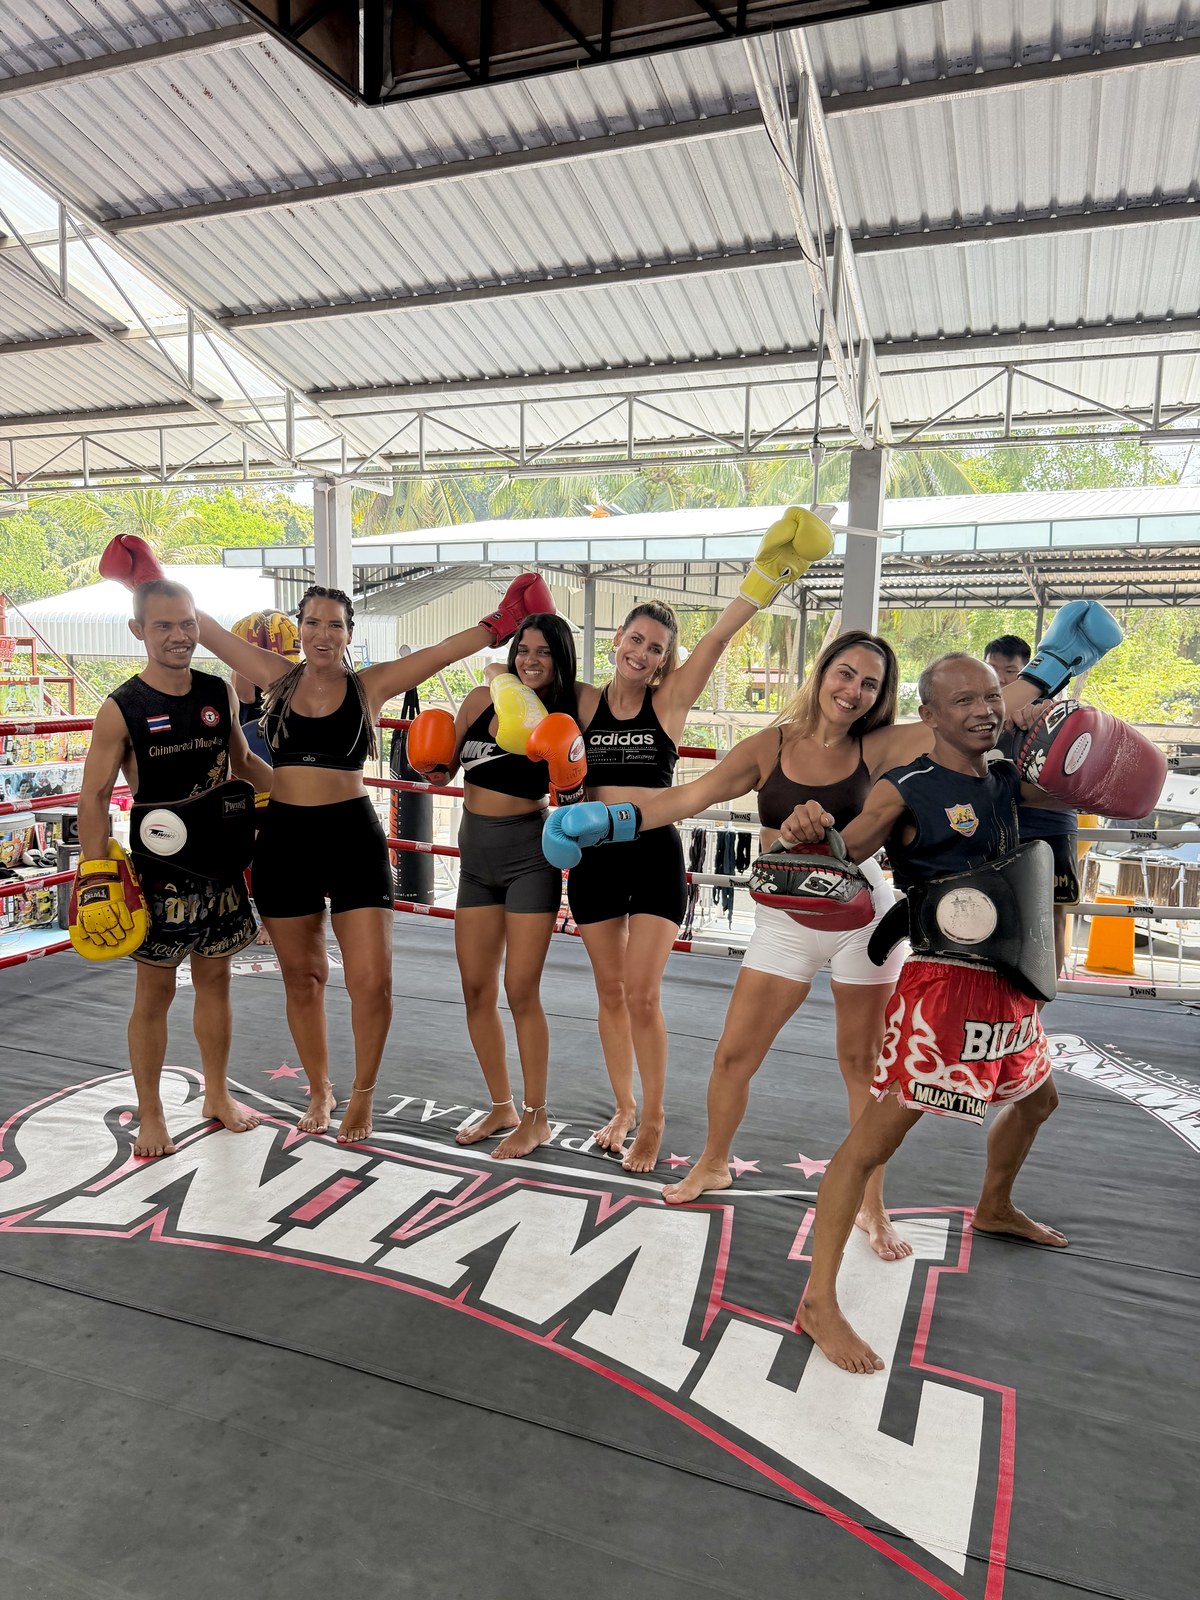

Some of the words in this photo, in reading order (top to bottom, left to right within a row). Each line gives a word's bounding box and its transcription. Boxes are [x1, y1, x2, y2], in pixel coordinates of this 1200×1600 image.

[590, 733, 655, 745] adidas
[462, 741, 496, 758] NIKE
[559, 784, 584, 802] TWINS
[225, 799, 246, 813] TWINS
[730, 811, 751, 821] TWINS
[1130, 831, 1157, 840] TWINS
[1127, 905, 1154, 915] TWINS
[728, 947, 746, 956] TWIN
[1129, 986, 1157, 997] TWINS
[915, 1085, 957, 1109] MUAY
[958, 1096, 987, 1117] THAI
[0, 1066, 984, 1575] TWINS
